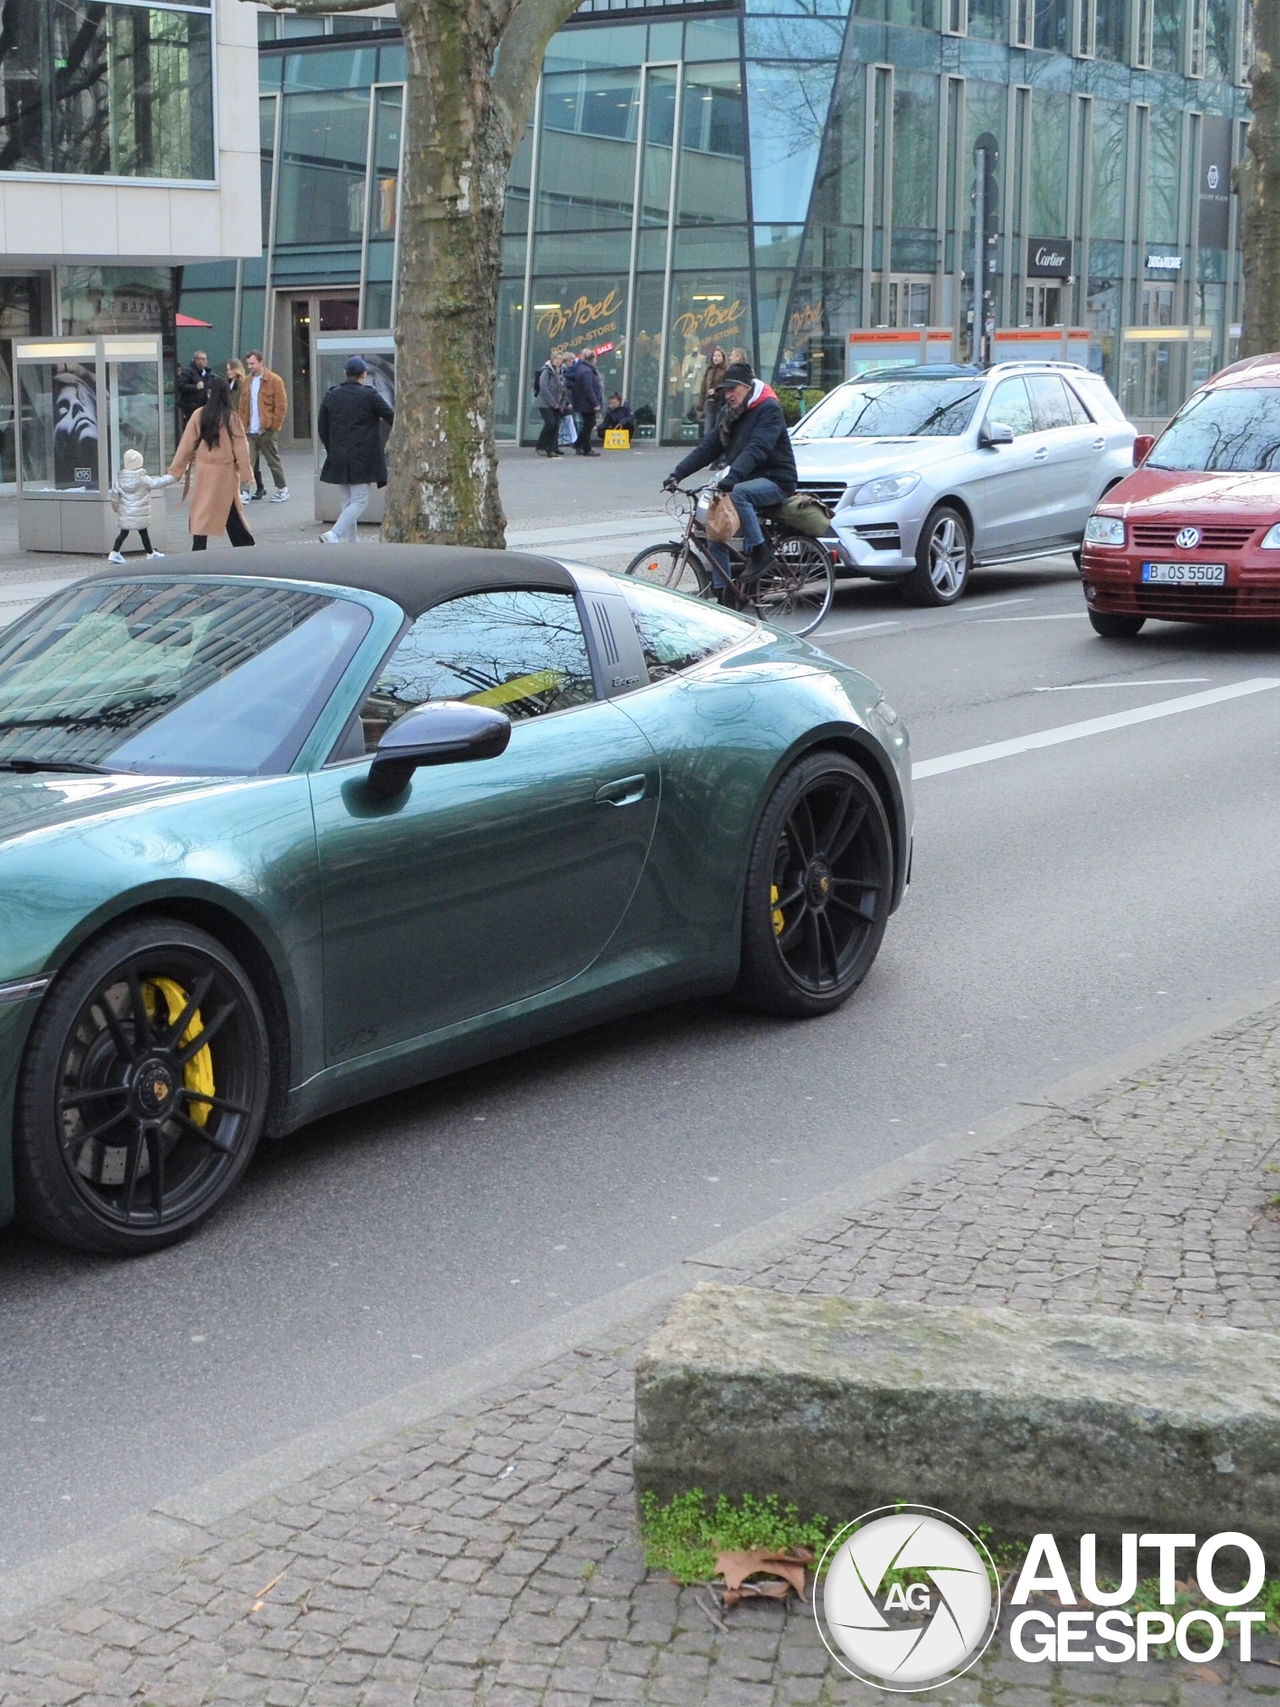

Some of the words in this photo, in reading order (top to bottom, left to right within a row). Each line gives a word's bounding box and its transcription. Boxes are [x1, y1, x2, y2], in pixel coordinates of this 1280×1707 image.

[1035, 247, 1065, 267] Cartier
[596, 342, 613, 353] SALE
[1150, 565, 1158, 579] B
[1168, 566, 1185, 580] OS
[1188, 566, 1223, 581] 5502
